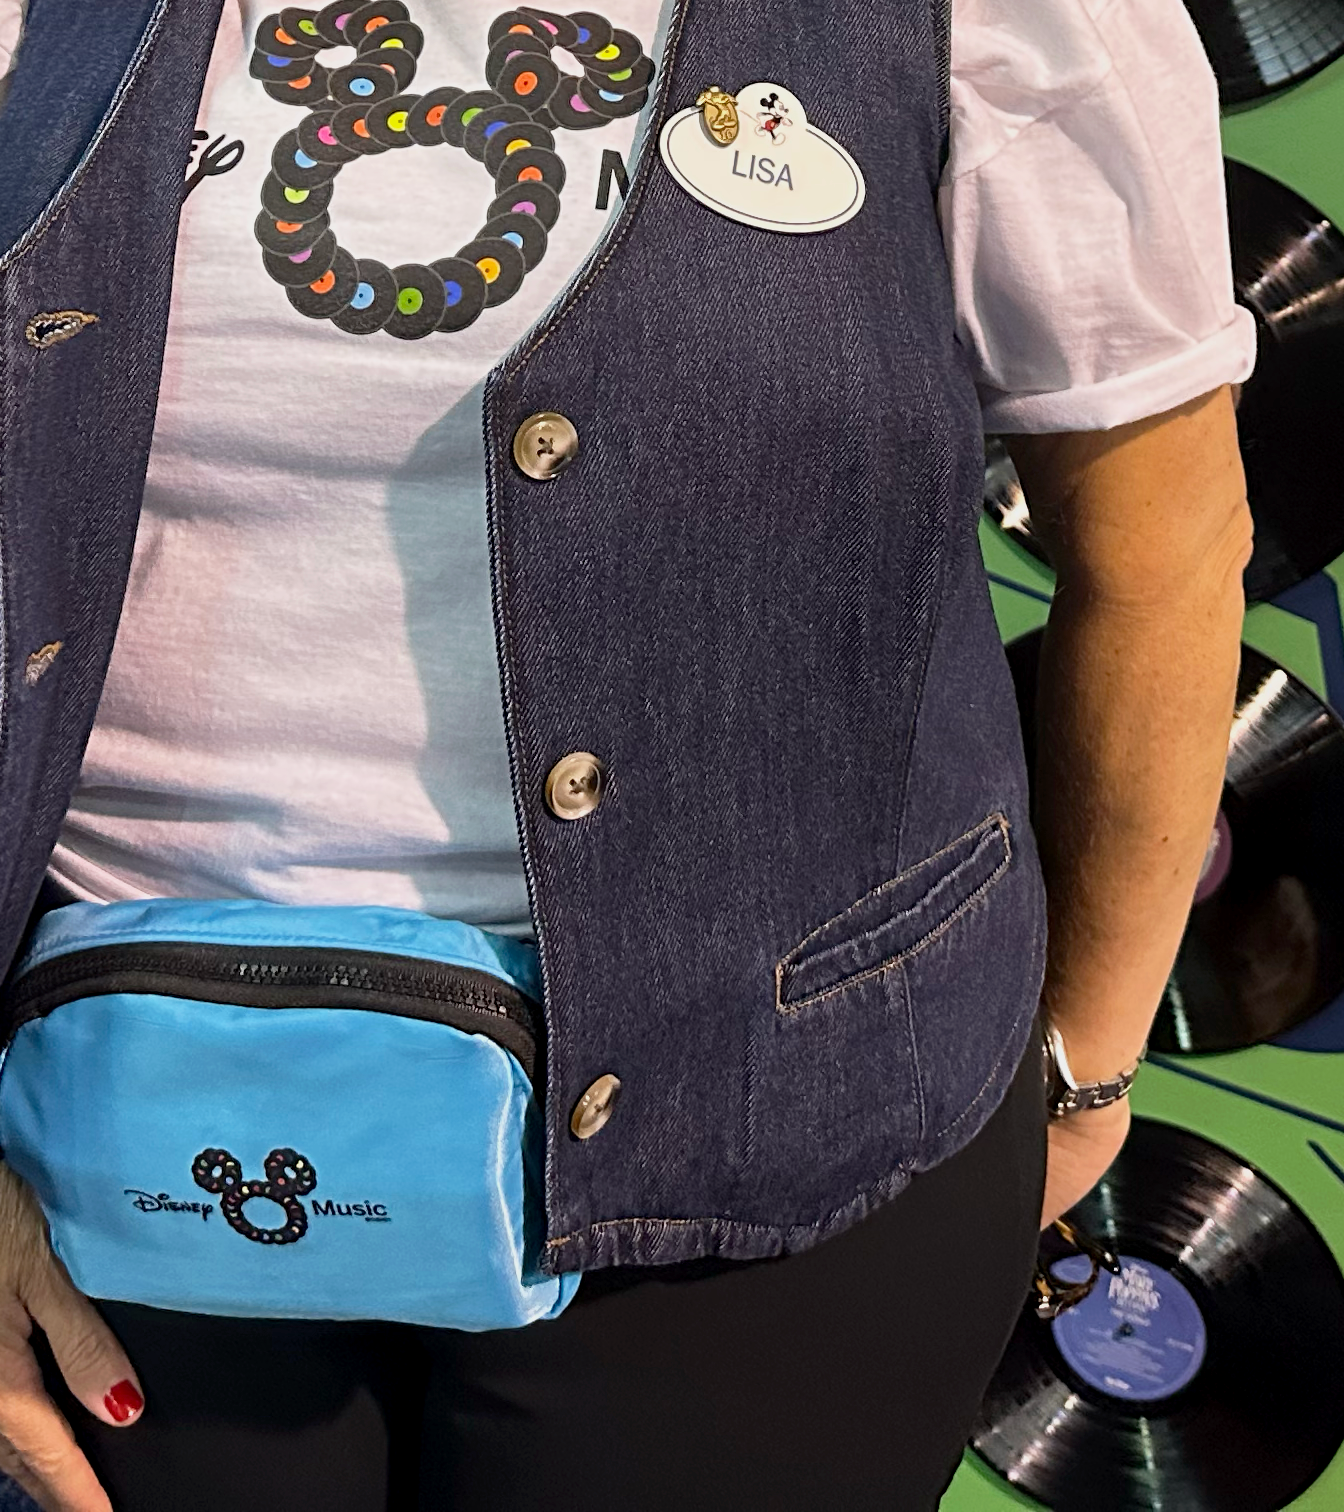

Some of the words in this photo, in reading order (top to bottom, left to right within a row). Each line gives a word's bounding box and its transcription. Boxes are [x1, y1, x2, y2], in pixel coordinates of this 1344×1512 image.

[732, 150, 793, 191] LISA
[124, 1189, 214, 1222] Disney
[311, 1199, 389, 1217] Music
